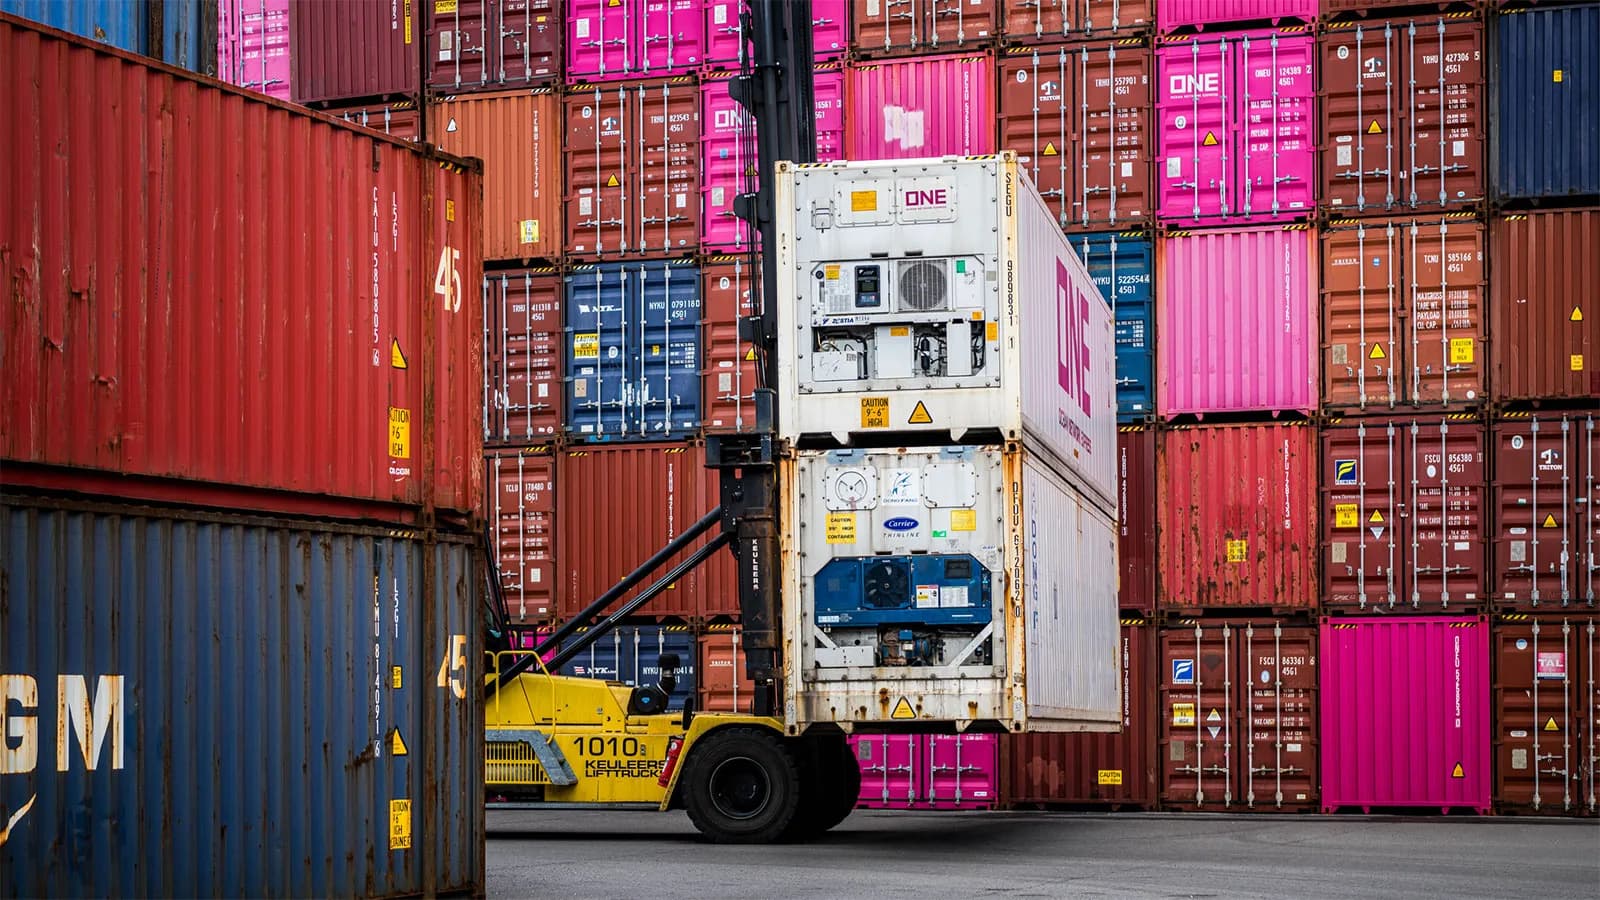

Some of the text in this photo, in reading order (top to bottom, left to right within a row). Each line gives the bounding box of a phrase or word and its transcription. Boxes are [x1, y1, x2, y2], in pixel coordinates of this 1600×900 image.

[1423, 51, 1480, 64] TRHU 427306 5
[1255, 69, 1270, 78] ONEU
[1114, 76, 1136, 86] 557901
[1170, 73, 1218, 94] ONE
[905, 189, 946, 206] ONE
[1004, 172, 1013, 217] SEGU
[1424, 254, 1439, 264] TCNU
[1448, 252, 1472, 262] 585166
[434, 246, 462, 313] 45
[1092, 276, 1110, 286] NYKU
[592, 304, 614, 312] NYK
[649, 302, 665, 310] NYKU
[1416, 312, 1440, 320] PAYLOAD
[1056, 256, 1092, 418] ONE
[861, 399, 888, 408] CAUTION
[867, 418, 883, 427] HIGH
[1424, 454, 1440, 463] FSCU
[1448, 453, 1472, 462] 856380
[1260, 656, 1274, 665] FSCU
[1282, 656, 1304, 665] 863361
[1538, 658, 1564, 668] TAL
[437, 634, 466, 699] 45
[642, 666, 658, 675] NYKU
[0, 674, 125, 774] GM
[574, 736, 638, 756] 1010
[585, 760, 666, 769] KEULEERS
